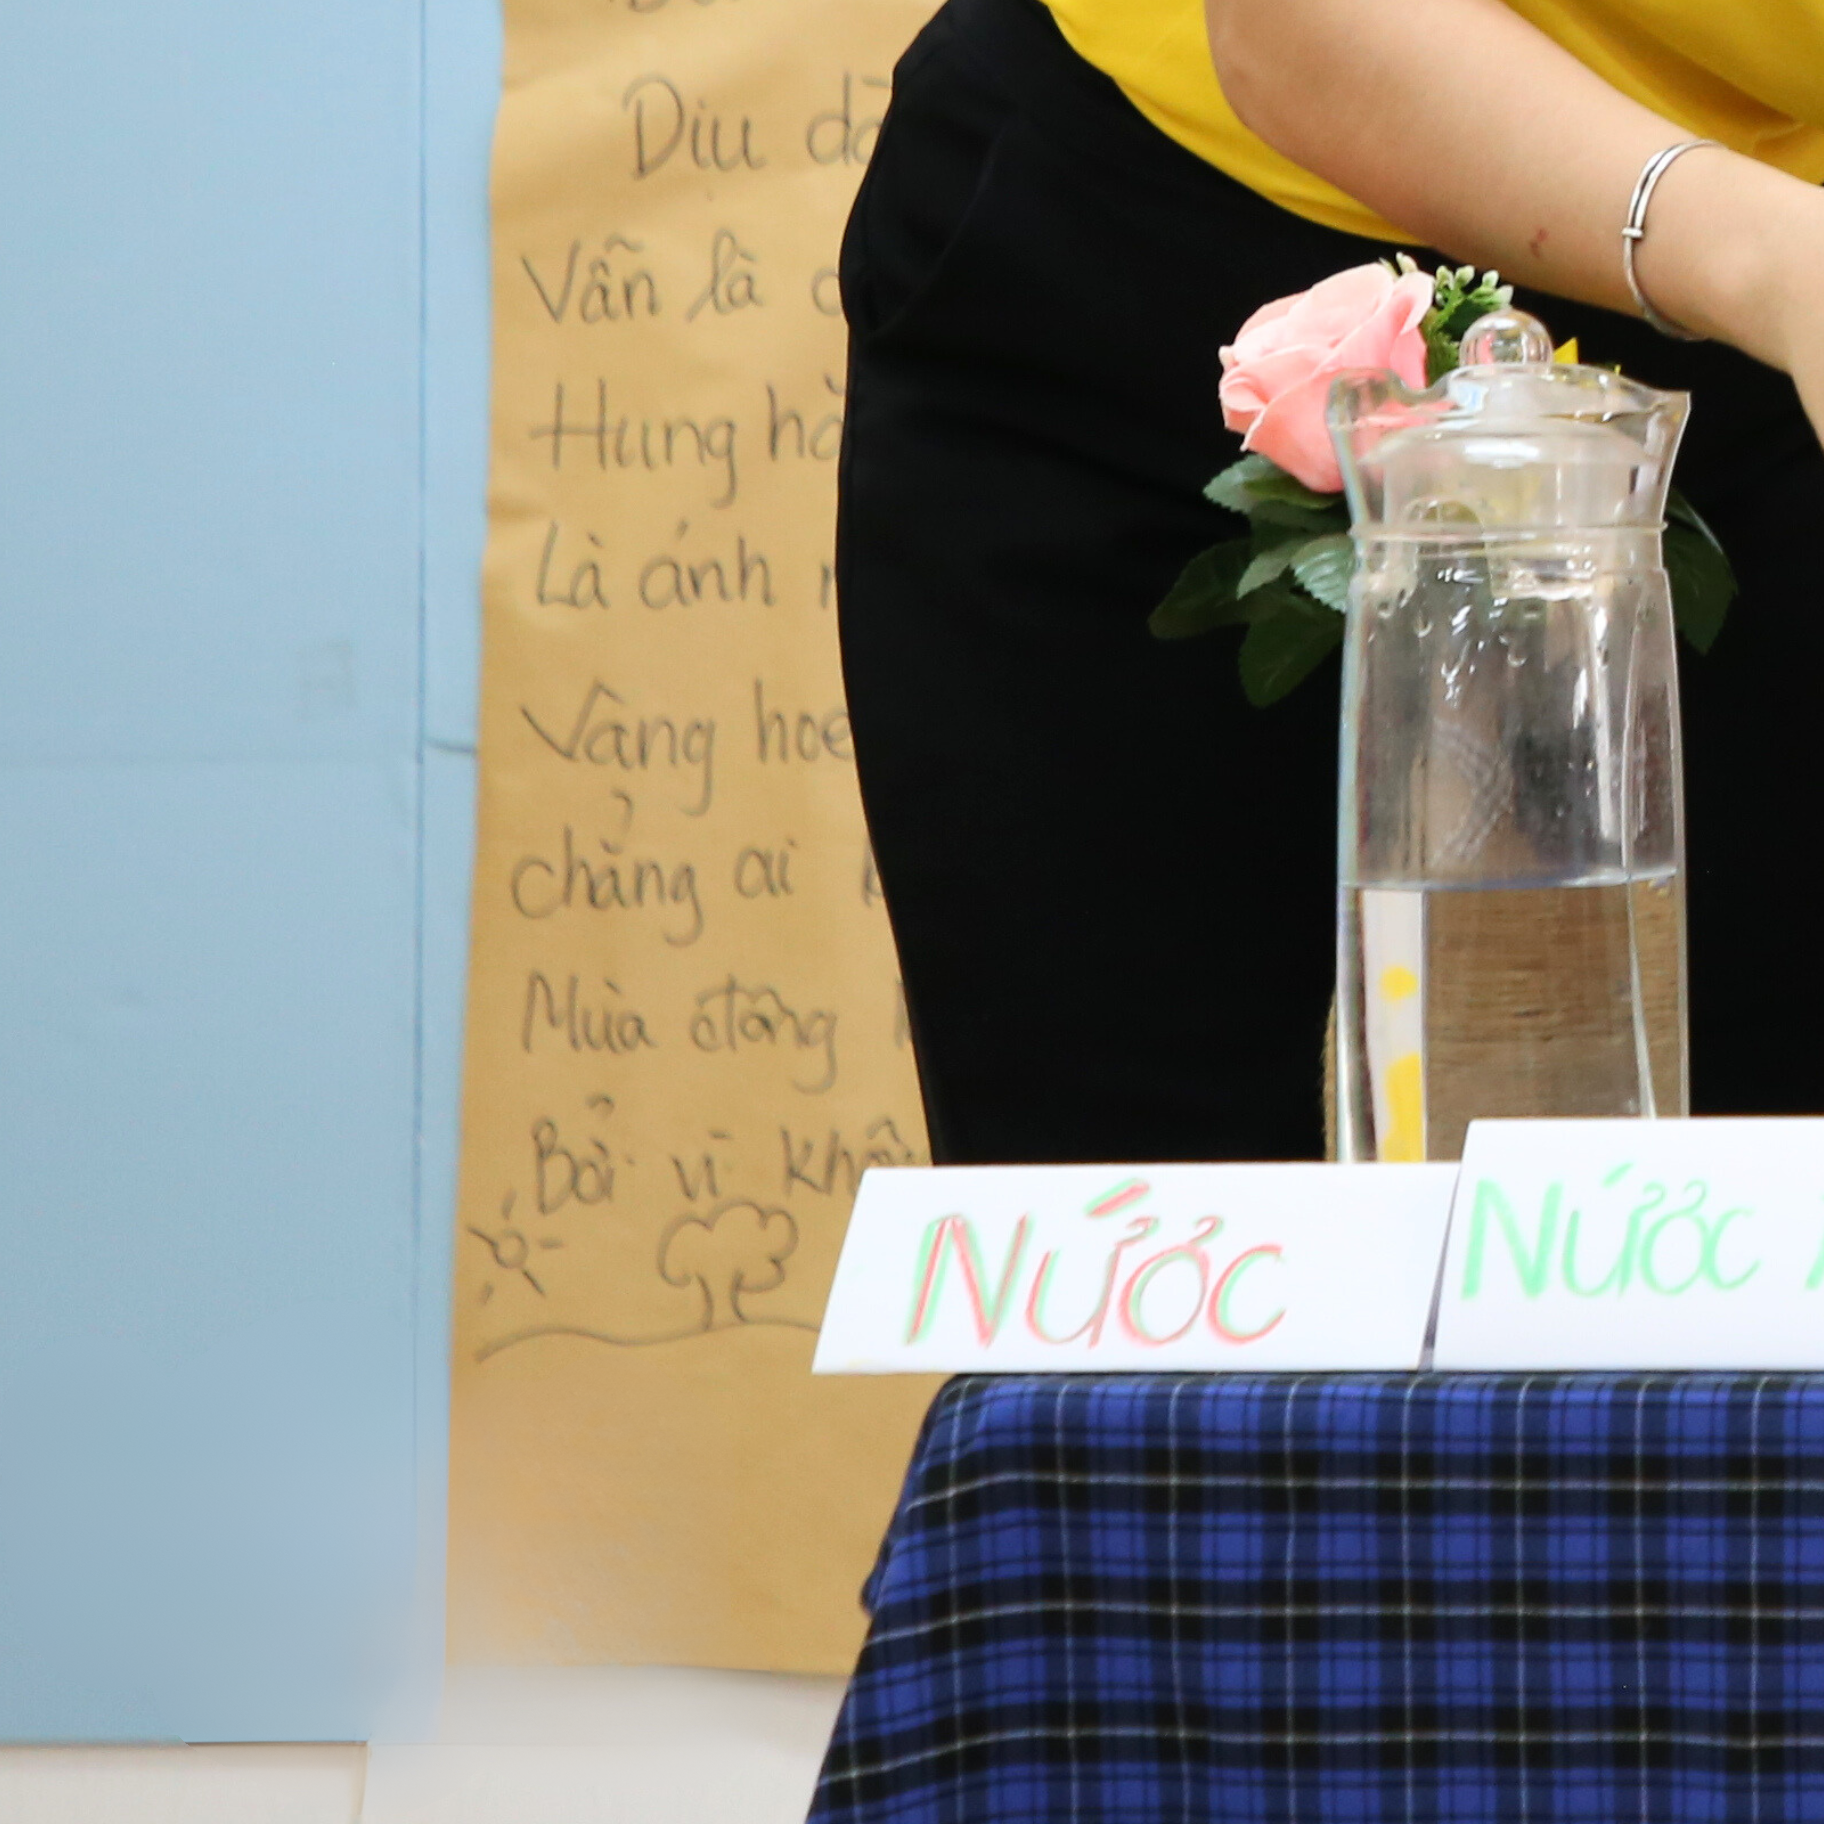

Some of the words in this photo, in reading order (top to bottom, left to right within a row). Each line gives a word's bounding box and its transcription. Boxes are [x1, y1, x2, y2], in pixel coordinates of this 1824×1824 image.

[521, 232, 660, 326] Vẫn
[686, 228, 763, 323] là
[529, 377, 739, 510] Hung
[536, 521, 609, 612] Là
[638, 518, 777, 610] ánh
[519, 678, 717, 817] Vàng
[734, 836, 800, 899] ai
[522, 969, 656, 1056] Mùa
[906, 1177, 1288, 1351] Nước
[1460, 1162, 1763, 1304] Nước
